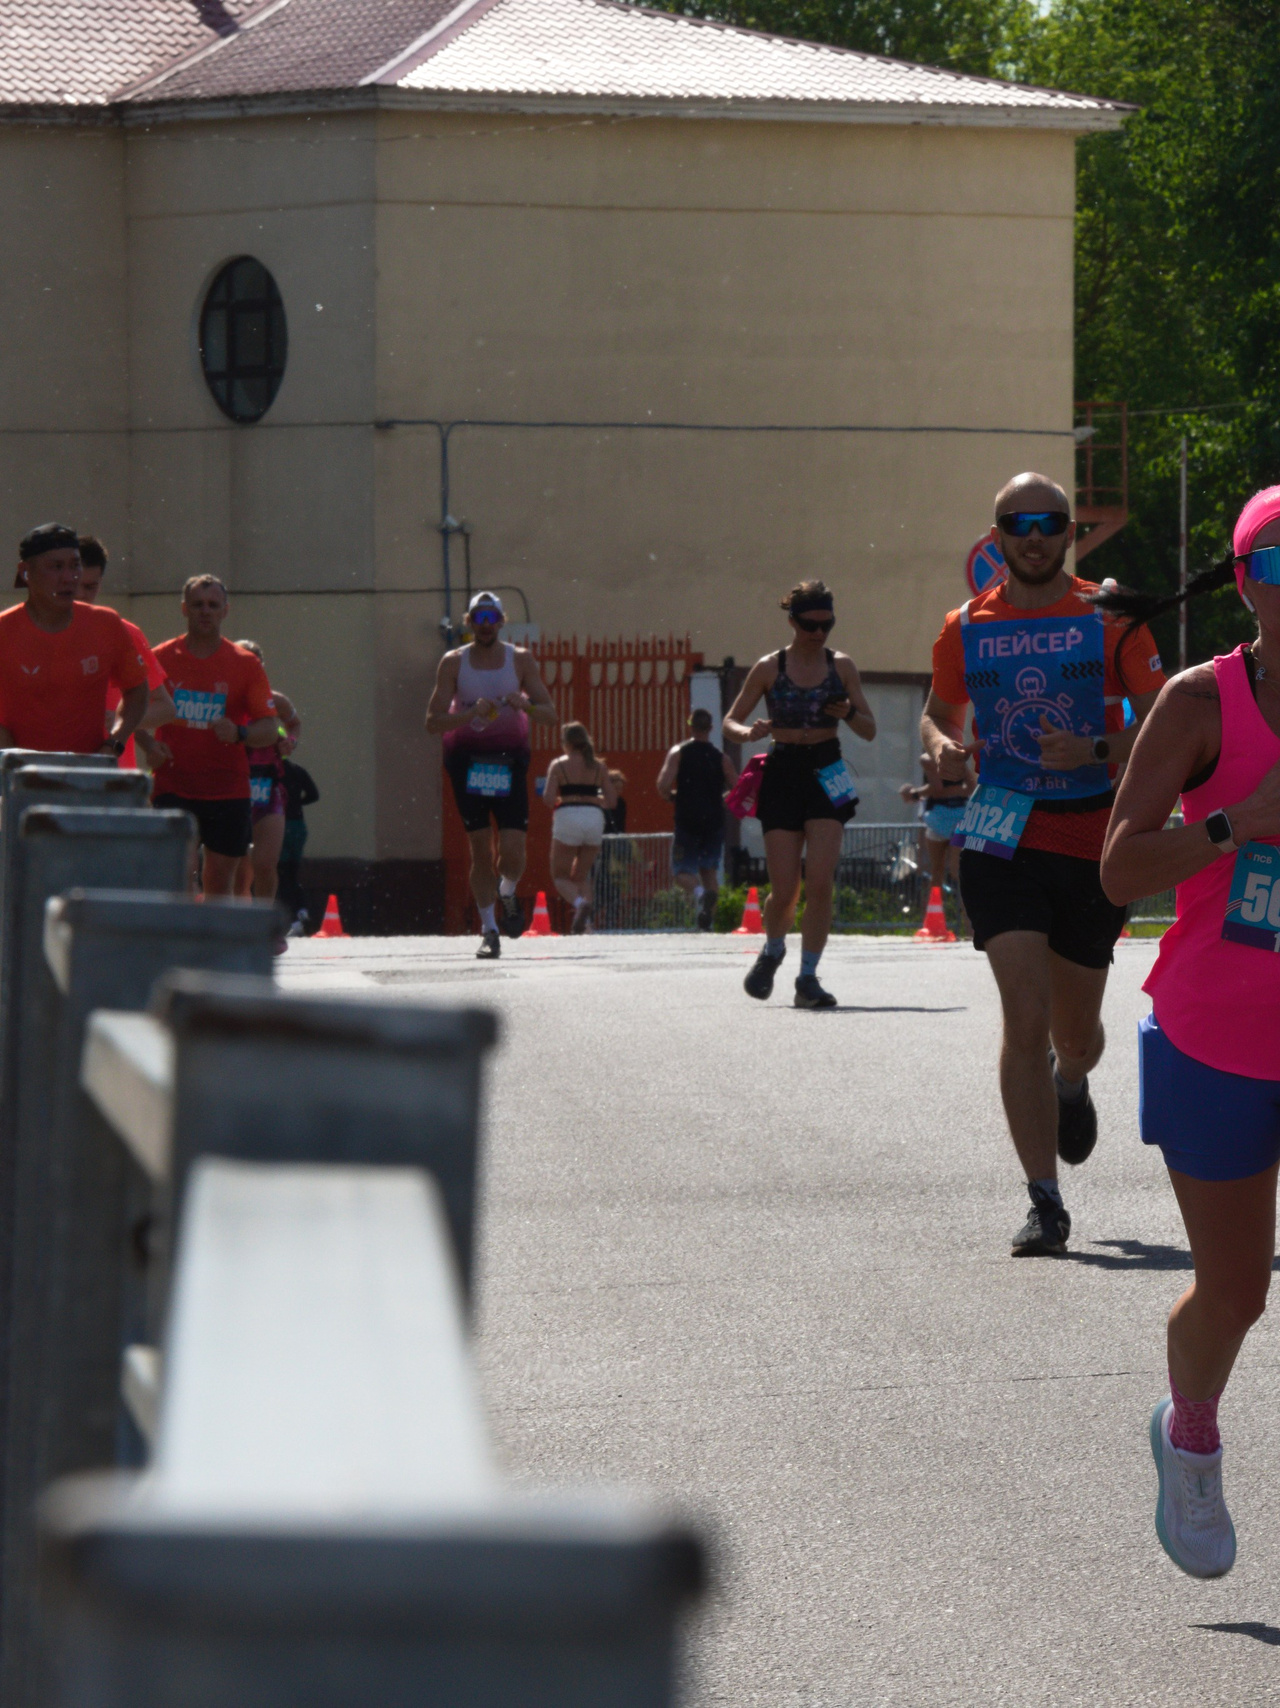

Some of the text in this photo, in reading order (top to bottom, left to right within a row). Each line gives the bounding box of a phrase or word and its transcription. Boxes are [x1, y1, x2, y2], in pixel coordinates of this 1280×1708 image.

[978, 630, 1083, 659] ПЕЙСЕР
[964, 835, 986, 852] 10KM
[1253, 854, 1272, 864] ПСБ
